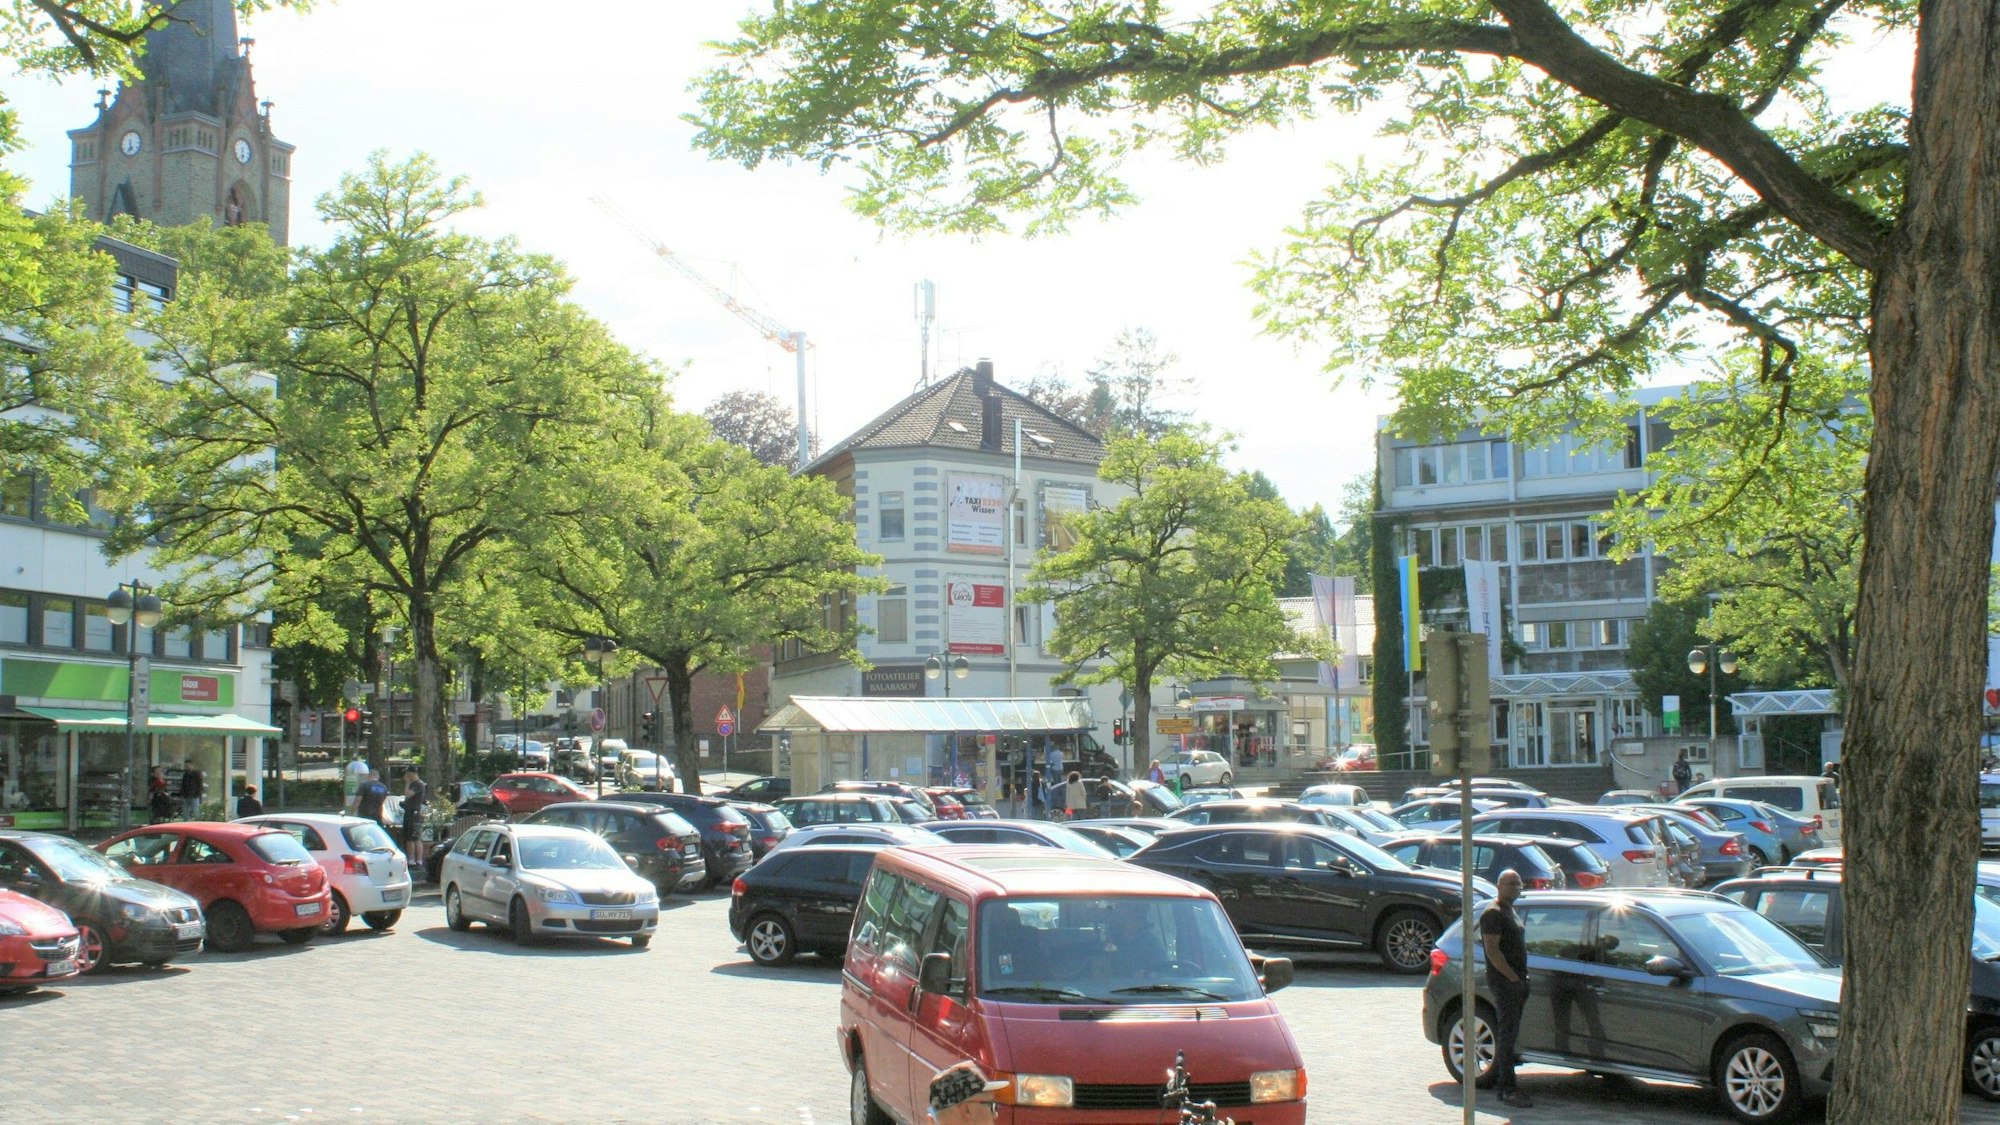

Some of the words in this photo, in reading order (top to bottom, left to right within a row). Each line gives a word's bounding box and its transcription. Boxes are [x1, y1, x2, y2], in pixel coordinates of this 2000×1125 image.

[965, 496, 981, 505] TAXI
[971, 505, 996, 514] Wisser
[866, 671, 921, 681] FOTOATELIER
[870, 682, 918, 692] BALABASOV
